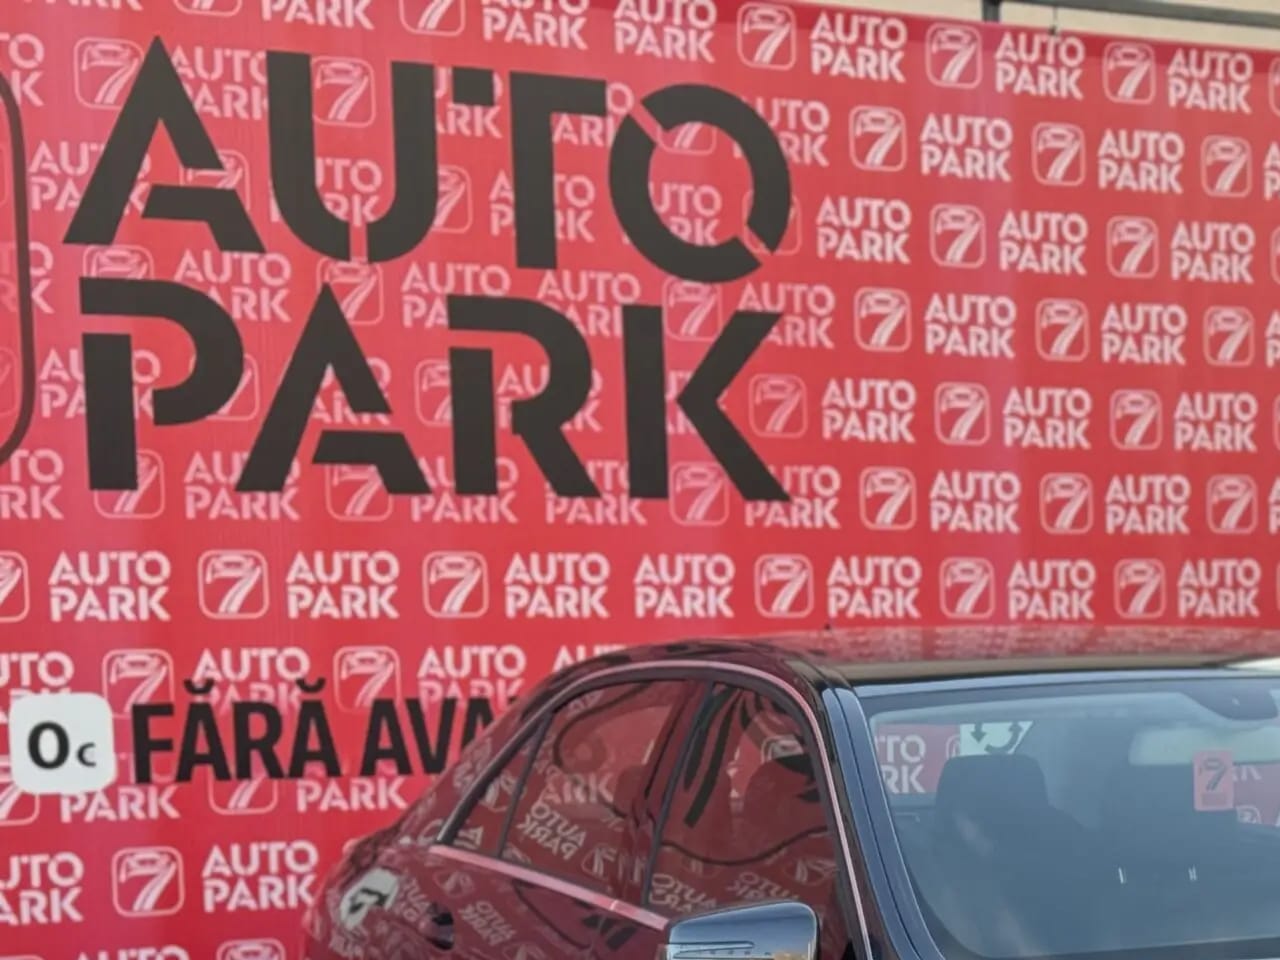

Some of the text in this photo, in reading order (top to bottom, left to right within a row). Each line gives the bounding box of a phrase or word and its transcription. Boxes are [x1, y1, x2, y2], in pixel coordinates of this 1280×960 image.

[482, 8, 588, 50] PARK
[614, 19, 715, 63] PARK
[809, 13, 908, 48] AUTO
[811, 40, 905, 83] PARK
[994, 33, 1085, 68] AUTO
[1166, 50, 1253, 84] AUTO
[995, 59, 1083, 100] PARK
[1167, 75, 1251, 114] PARK
[920, 113, 1013, 150] AUTO
[1098, 129, 1185, 164] AUTO
[62, 35, 793, 284] AUTO
[921, 143, 1012, 183] PARK
[1098, 157, 1183, 194] PARK
[816, 196, 912, 232] AUTO
[998, 210, 1088, 244] AUTO
[817, 226, 910, 264] PARK
[1171, 222, 1256, 254] AUTO
[174, 249, 292, 286] AUTO
[999, 239, 1087, 276] PARK
[1171, 248, 1254, 284] PARK
[402, 262, 512, 297] AUTO
[536, 270, 641, 303] AUTO
[738, 284, 837, 317] AUTO
[924, 293, 1017, 328] AUTO
[1101, 303, 1188, 335] AUTO
[925, 322, 1015, 359] PARK
[1101, 332, 1186, 365] PARK
[79, 276, 794, 503] PARK
[821, 378, 917, 412] AUTO
[1002, 386, 1092, 419] AUTO
[1174, 392, 1258, 423] AUTO
[822, 409, 915, 443] PARK
[1003, 415, 1091, 450] PARK
[1174, 419, 1257, 452] PARK
[185, 486, 300, 521] PARK
[929, 471, 1022, 503] AUTO
[1105, 474, 1191, 506] AUTO
[411, 489, 518, 523] PARK
[545, 492, 647, 525] PARK
[744, 496, 840, 529] PARK
[930, 498, 1020, 534] PARK
[1105, 502, 1189, 534] PARK
[48, 551, 171, 586] AUTO
[286, 550, 400, 585] AUTO
[504, 552, 610, 585] AUTO
[634, 553, 735, 586] AUTO
[827, 556, 922, 588] AUTO
[1007, 559, 1096, 590] AUTO
[1177, 558, 1262, 589] AUTO
[50, 586, 170, 622] PARK
[287, 584, 399, 619] PARK
[505, 584, 609, 618] PARK
[635, 584, 734, 618] PARK
[828, 585, 920, 618] PARK
[1008, 588, 1095, 620] PARK
[1178, 587, 1259, 618] PARK
[192, 647, 311, 684] AUTO
[416, 643, 527, 679] AUTO
[132, 677, 342, 785] FĂRĂ
[60, 785, 181, 823] PARK
[296, 776, 409, 813] PARK
[0, 852, 84, 890] UTO
[202, 840, 319, 879] AUTO
[0, 887, 83, 926] ARK
[203, 873, 316, 913] PARK
